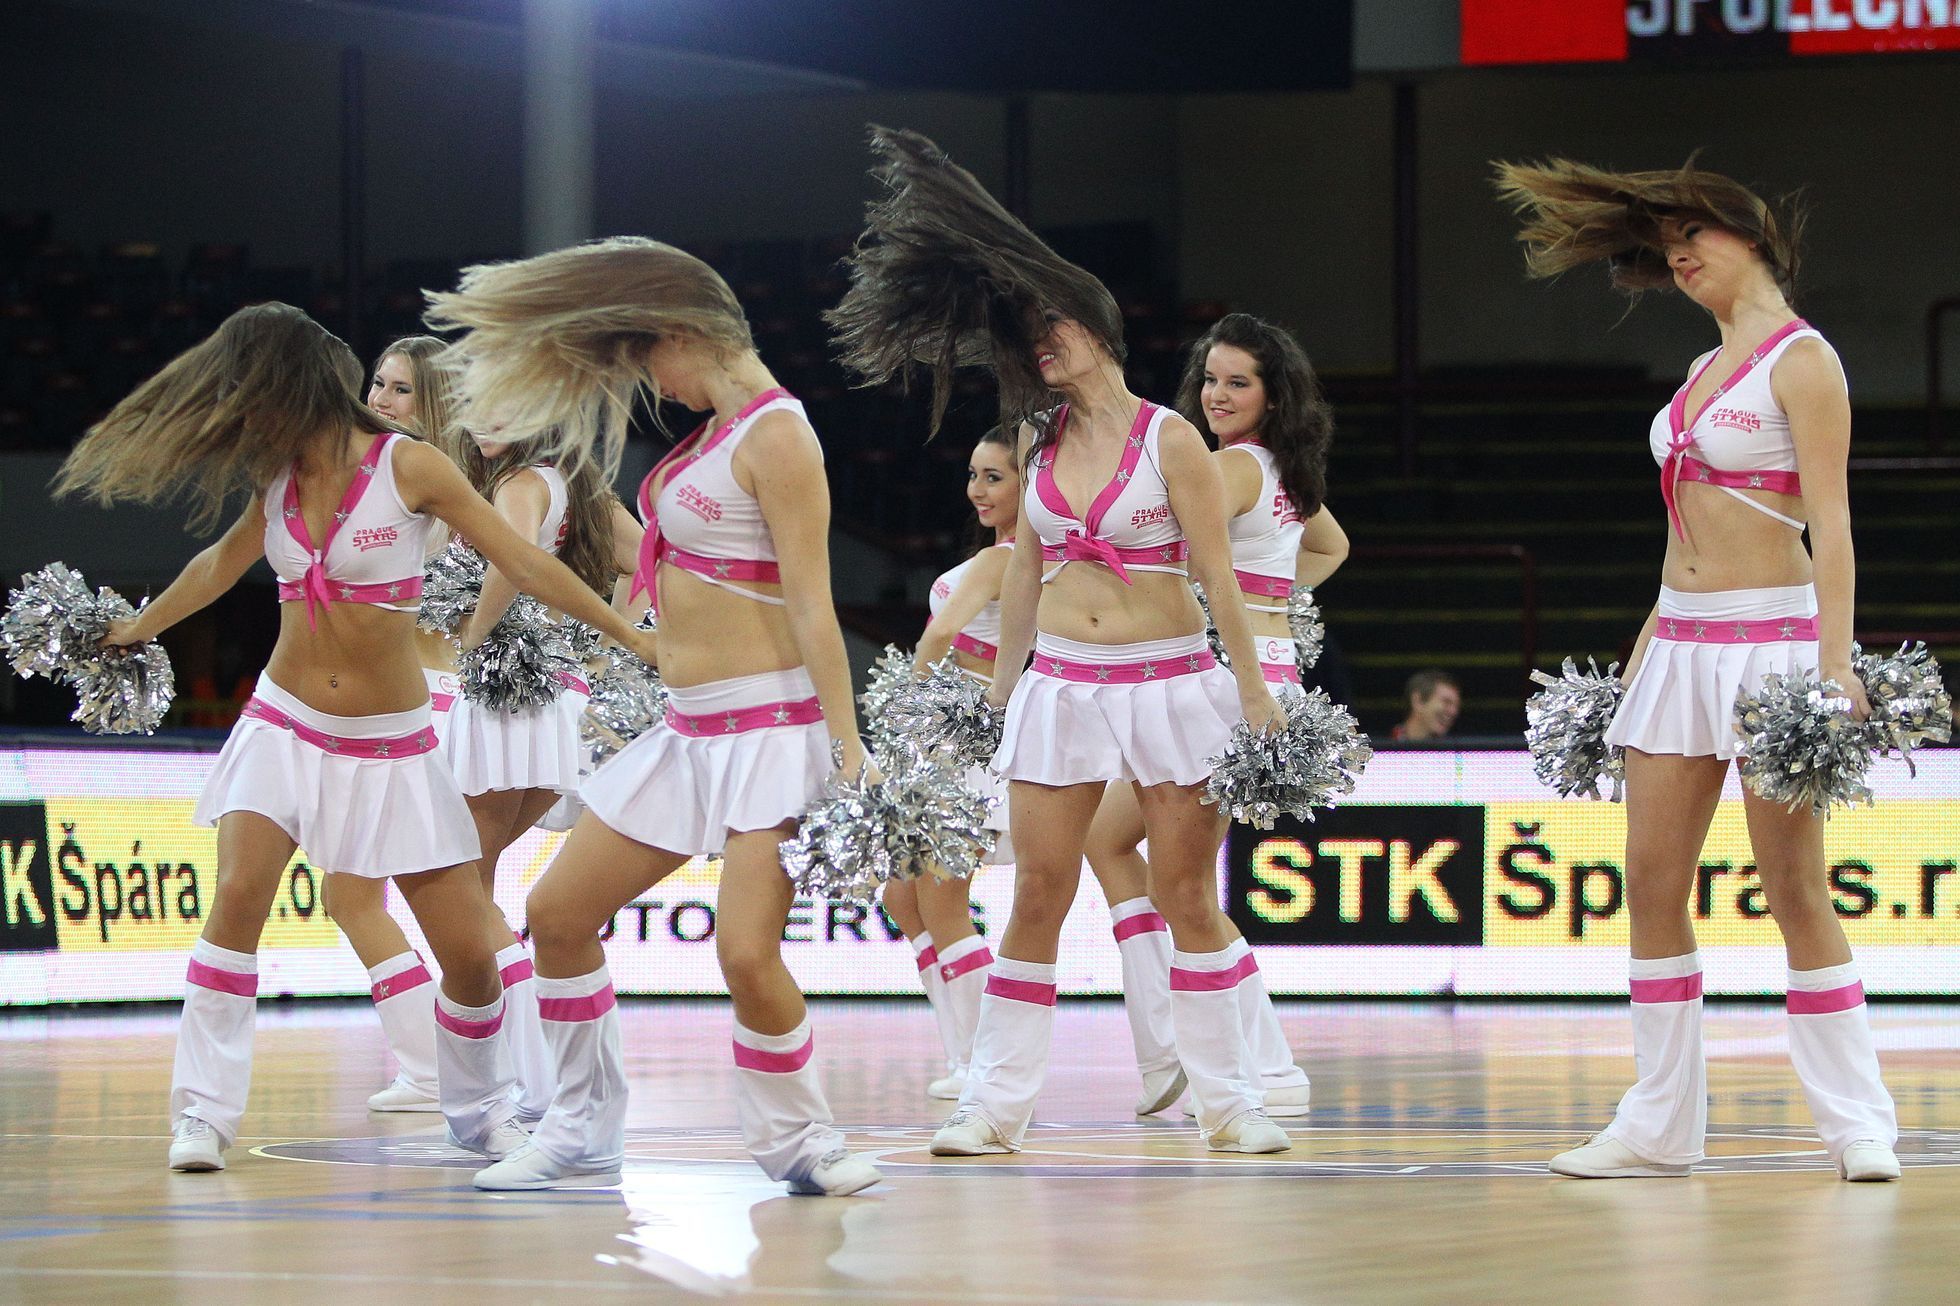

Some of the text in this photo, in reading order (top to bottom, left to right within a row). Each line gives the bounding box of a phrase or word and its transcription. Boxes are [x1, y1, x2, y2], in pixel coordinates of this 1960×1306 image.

[1709, 413, 1761, 430] STARS
[1717, 408, 1757, 419] PRAGUE
[676, 488, 722, 521] STARS
[1131, 508, 1168, 526] STARS
[353, 531, 397, 547] STARS
[355, 526, 393, 536] PRAGUE
[58, 822, 200, 943] Špára
[1246, 839, 1460, 924] STK
